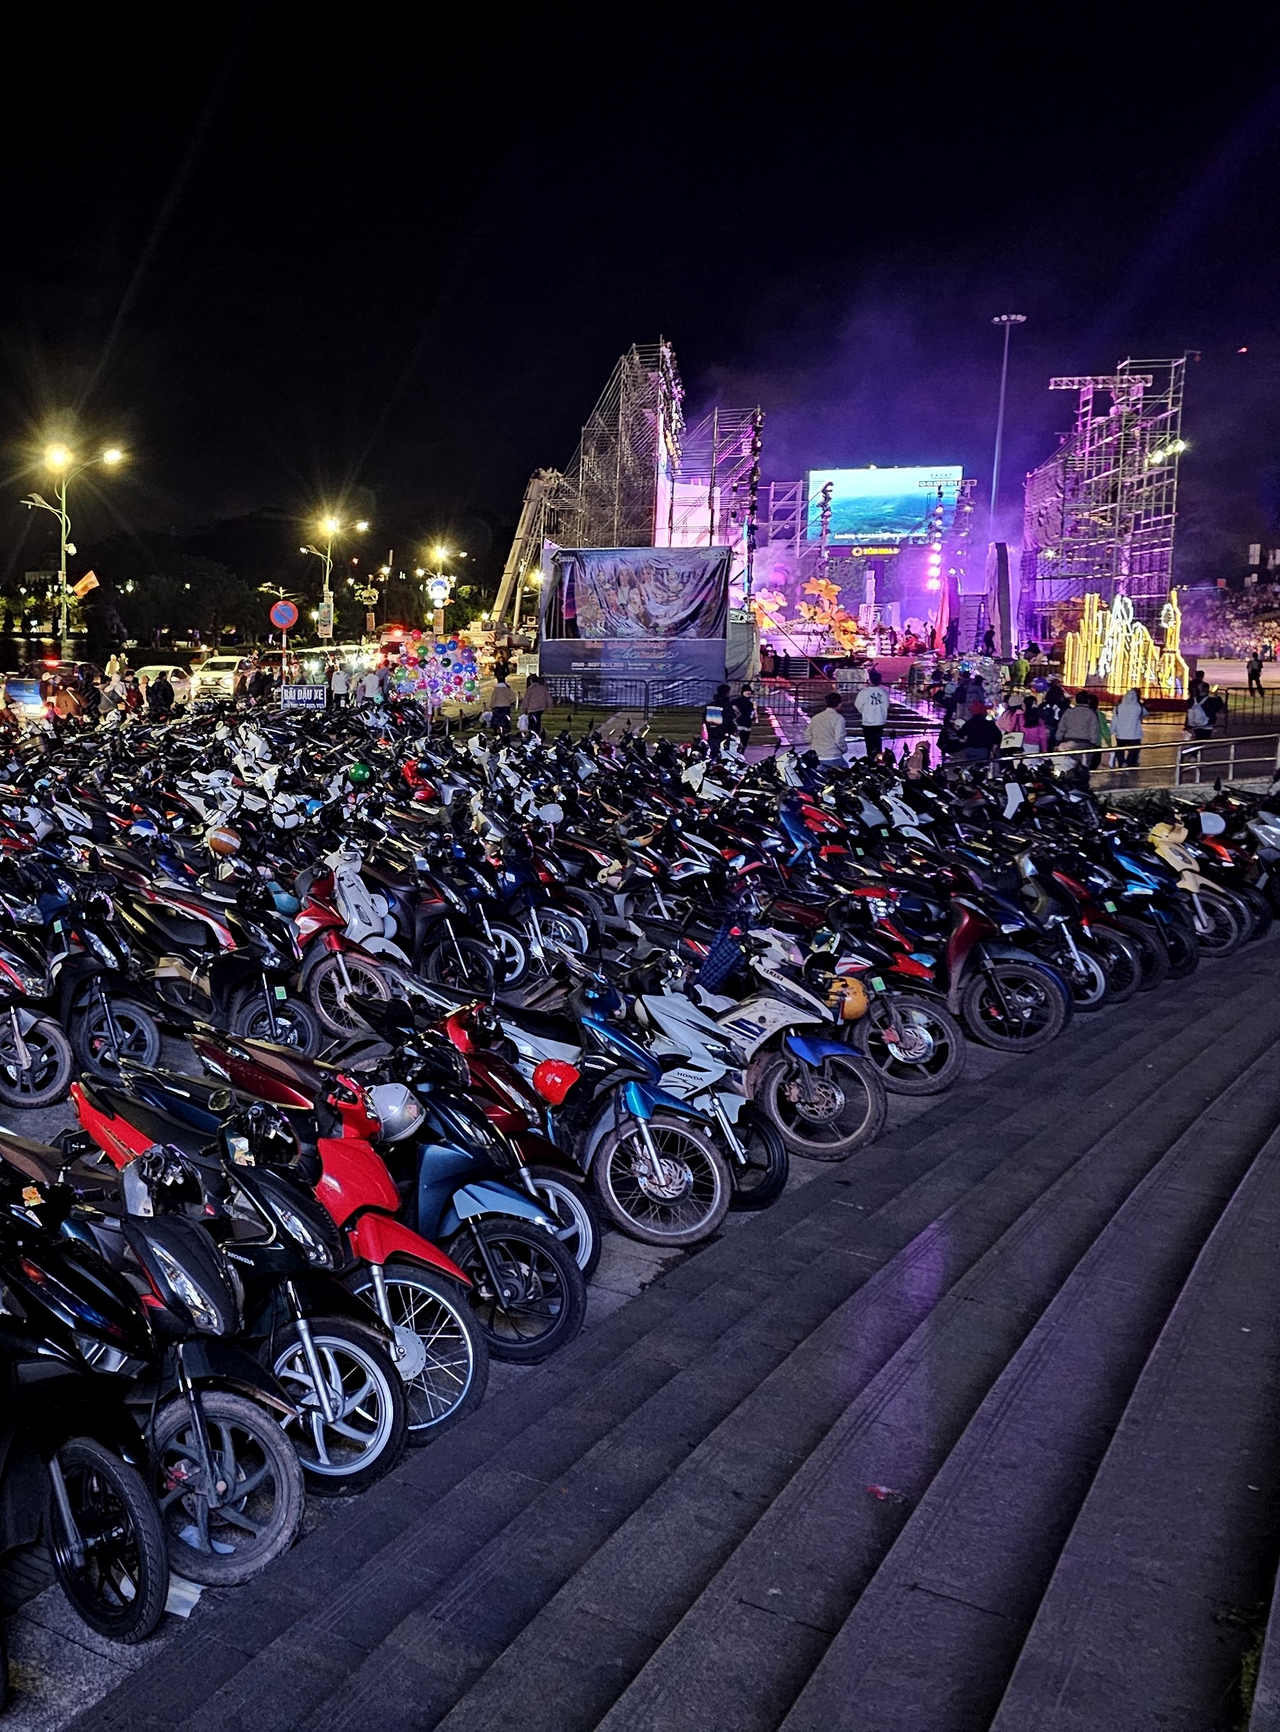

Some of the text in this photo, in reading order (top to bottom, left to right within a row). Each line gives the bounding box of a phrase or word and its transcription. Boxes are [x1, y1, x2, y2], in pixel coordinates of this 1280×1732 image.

[313, 689, 324, 700] XE
[677, 1071, 704, 1082] HONDA
[227, 1251, 255, 1266] HONDA
